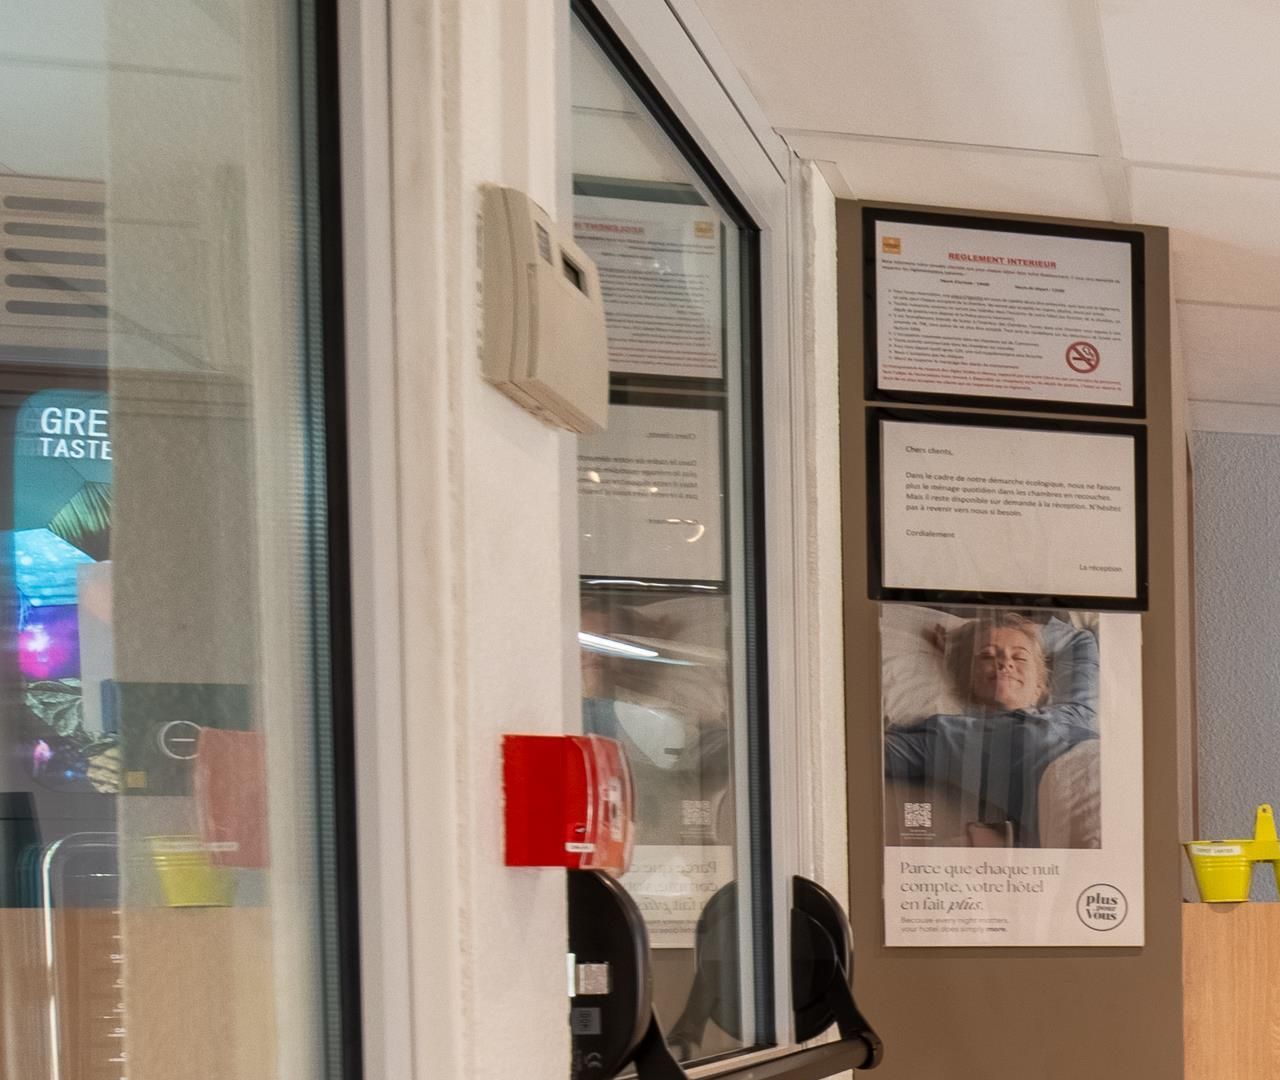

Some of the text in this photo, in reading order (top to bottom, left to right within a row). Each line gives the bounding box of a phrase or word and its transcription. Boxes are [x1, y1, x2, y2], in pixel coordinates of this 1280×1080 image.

[948, 252, 1056, 269] REGLEMENT INTERIEUR
[906, 472, 924, 480] Dans
[933, 473, 954, 482] cadre
[967, 476, 987, 484] notre
[900, 862, 1060, 879] Parce que chaque nuit
[900, 880, 1044, 896] compte, votre hôtel
[900, 897, 983, 914] en fait plus.
[1087, 893, 1117, 907] plus
